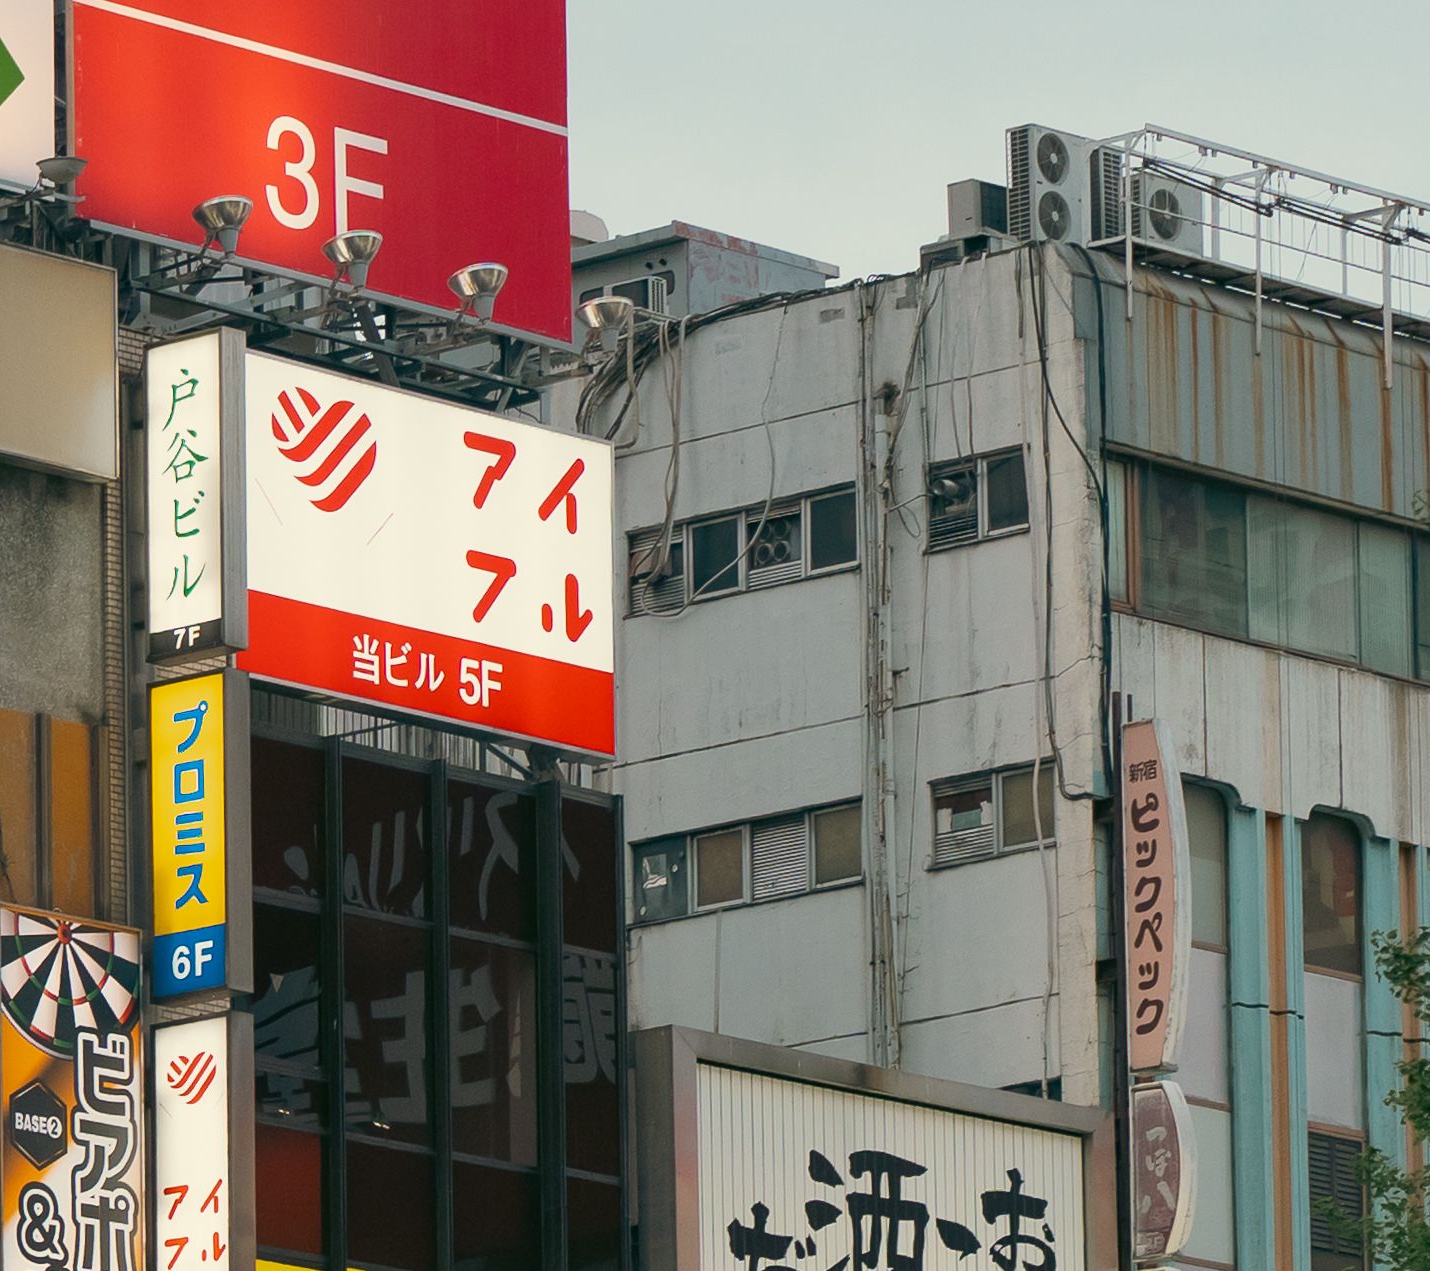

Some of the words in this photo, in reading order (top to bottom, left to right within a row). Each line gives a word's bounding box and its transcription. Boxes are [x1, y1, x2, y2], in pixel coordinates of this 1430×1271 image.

[264, 114, 389, 234] 3F
[162, 369, 208, 601] 戸谷ビル
[173, 626, 201, 650] 7F
[352, 632, 445, 694] 当ビル
[459, 657, 503, 707] 5F
[173, 700, 209, 910] プロミス
[1129, 760, 1158, 783] 新宿
[171, 939, 214, 980] 6F
